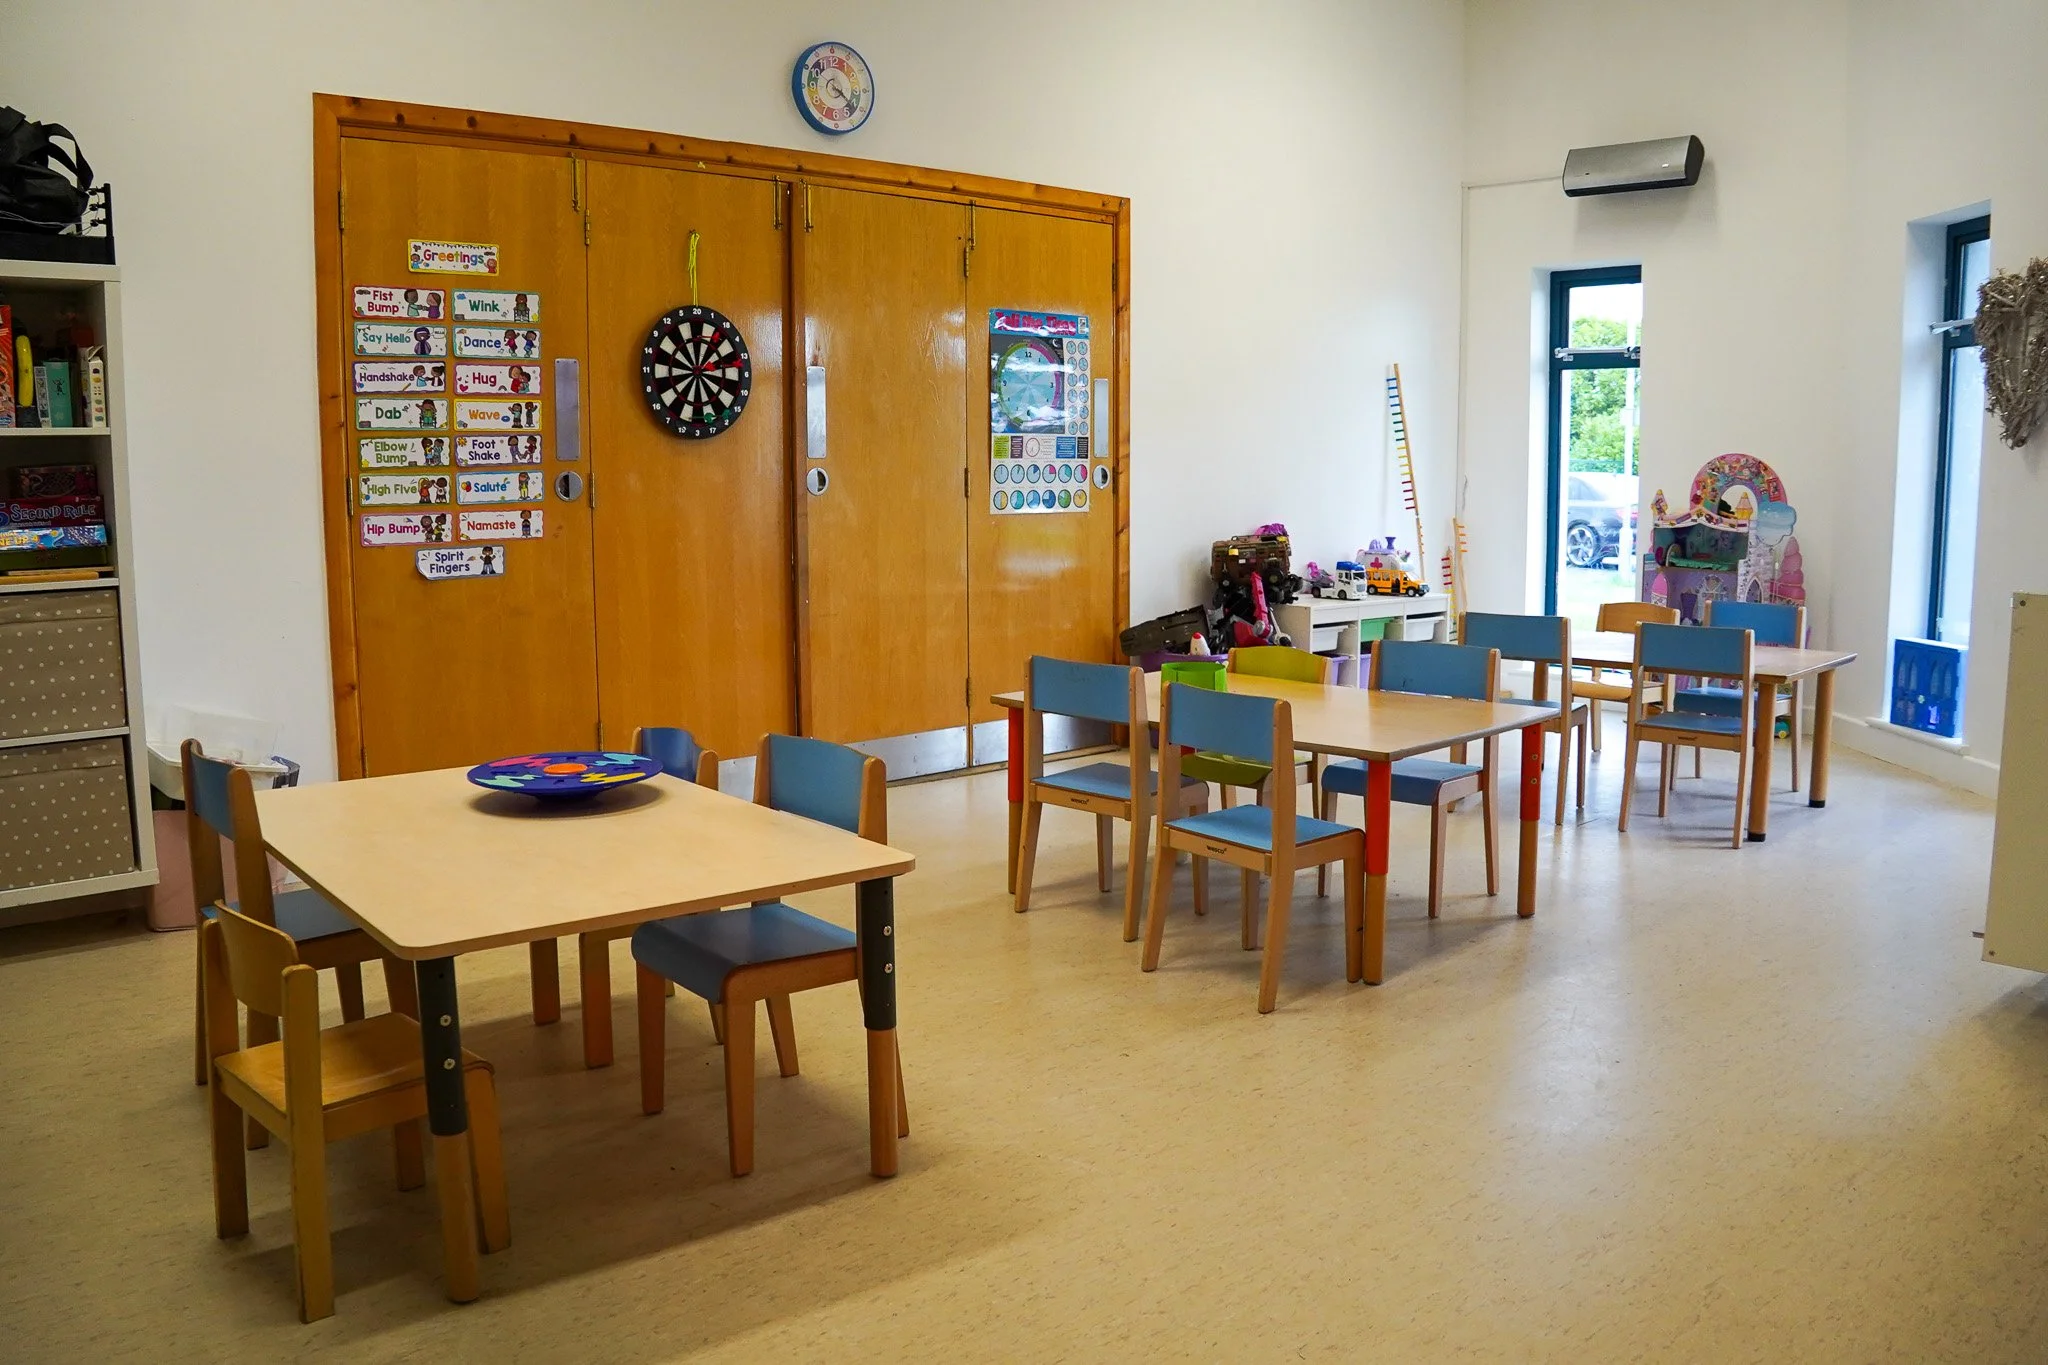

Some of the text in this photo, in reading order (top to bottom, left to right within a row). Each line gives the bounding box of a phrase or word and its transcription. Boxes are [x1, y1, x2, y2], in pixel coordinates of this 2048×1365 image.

[819, 60, 826, 69] 11
[829, 57, 838, 67] 12
[844, 63, 847, 71] 1
[812, 69, 820, 78] 10
[810, 82, 816, 91] 9
[813, 96, 820, 104] 8
[822, 106, 827, 115] 7
[833, 110, 839, 119] 6
[843, 107, 849, 117] 5
[424, 249, 484, 266] Greetings
[373, 290, 393, 301] Fist
[368, 302, 399, 314] Bump
[469, 300, 500, 312] Wink
[363, 333, 411, 344] Say Hello
[464, 336, 501, 348] Dance
[360, 373, 415, 382] Handshake
[472, 373, 497, 386] Hug
[376, 407, 402, 420] Dab
[469, 410, 500, 421] Wave
[374, 442, 407, 452] Elbow
[472, 439, 496, 449] Foot
[376, 454, 407, 465] Bump
[469, 450, 501, 460] Shake
[367, 484, 417, 496] High Five
[474, 482, 507, 493] Salute
[11, 503, 61, 521] SECOND
[63, 504, 96, 520] RULE
[367, 523, 420, 536] Hip Bump
[467, 520, 516, 532] Namaste
[435, 552, 464, 563] Spirit
[430, 563, 470, 575] Fingers
